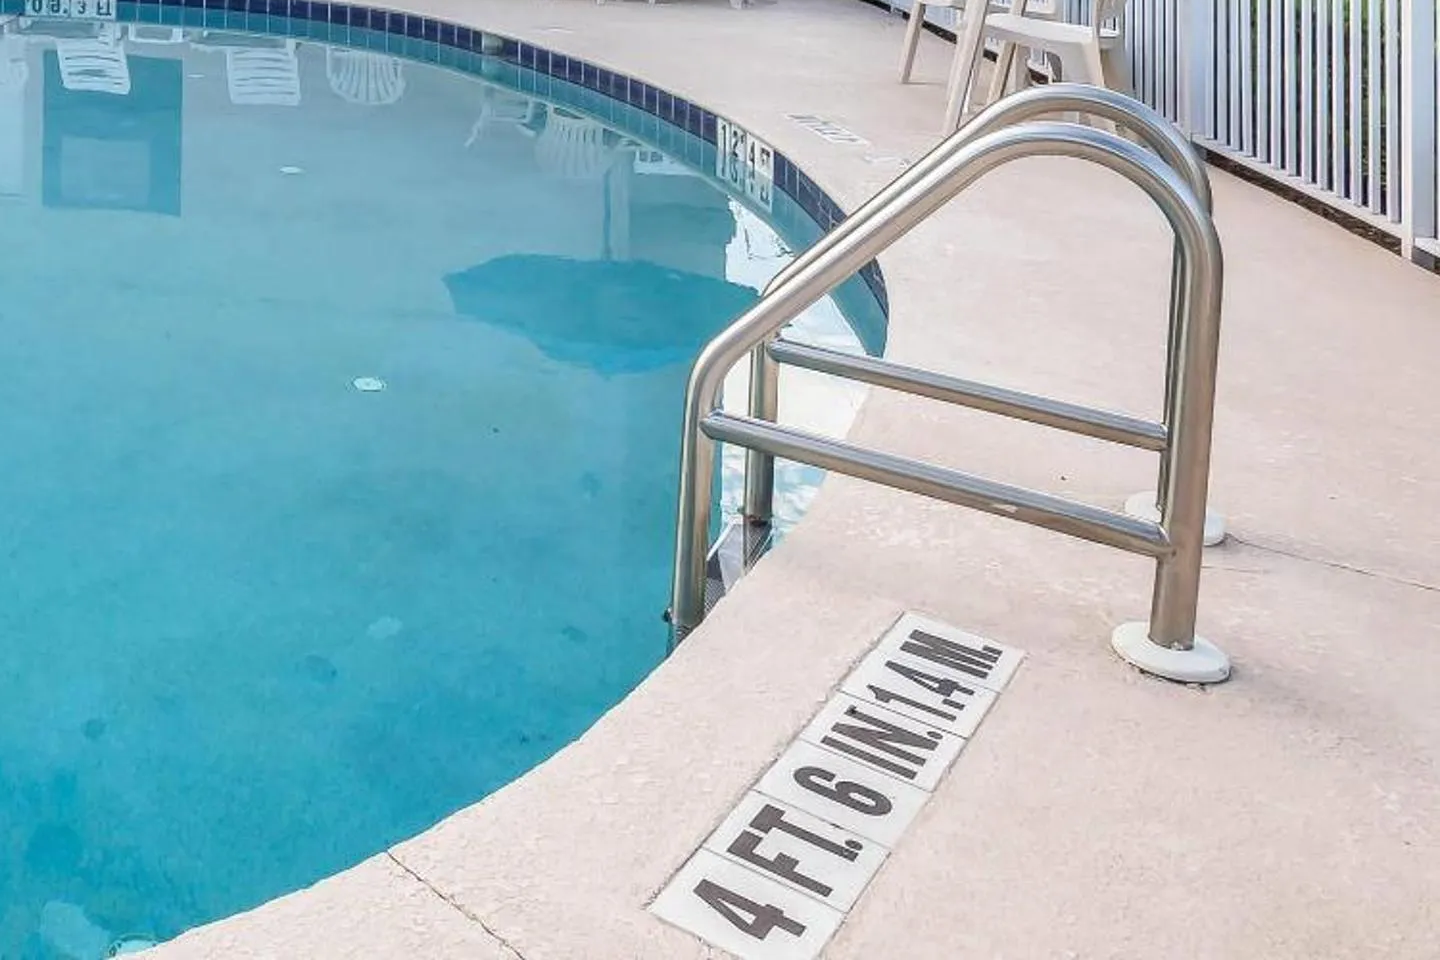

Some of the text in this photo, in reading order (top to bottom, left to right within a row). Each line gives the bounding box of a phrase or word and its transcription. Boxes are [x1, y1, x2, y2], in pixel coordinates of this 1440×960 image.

[899, 628, 1003, 680] M.
[820, 704, 944, 781] IN.
[792, 765, 893, 817] 6
[727, 803, 863, 898] FT.
[692, 878, 807, 940] 4
